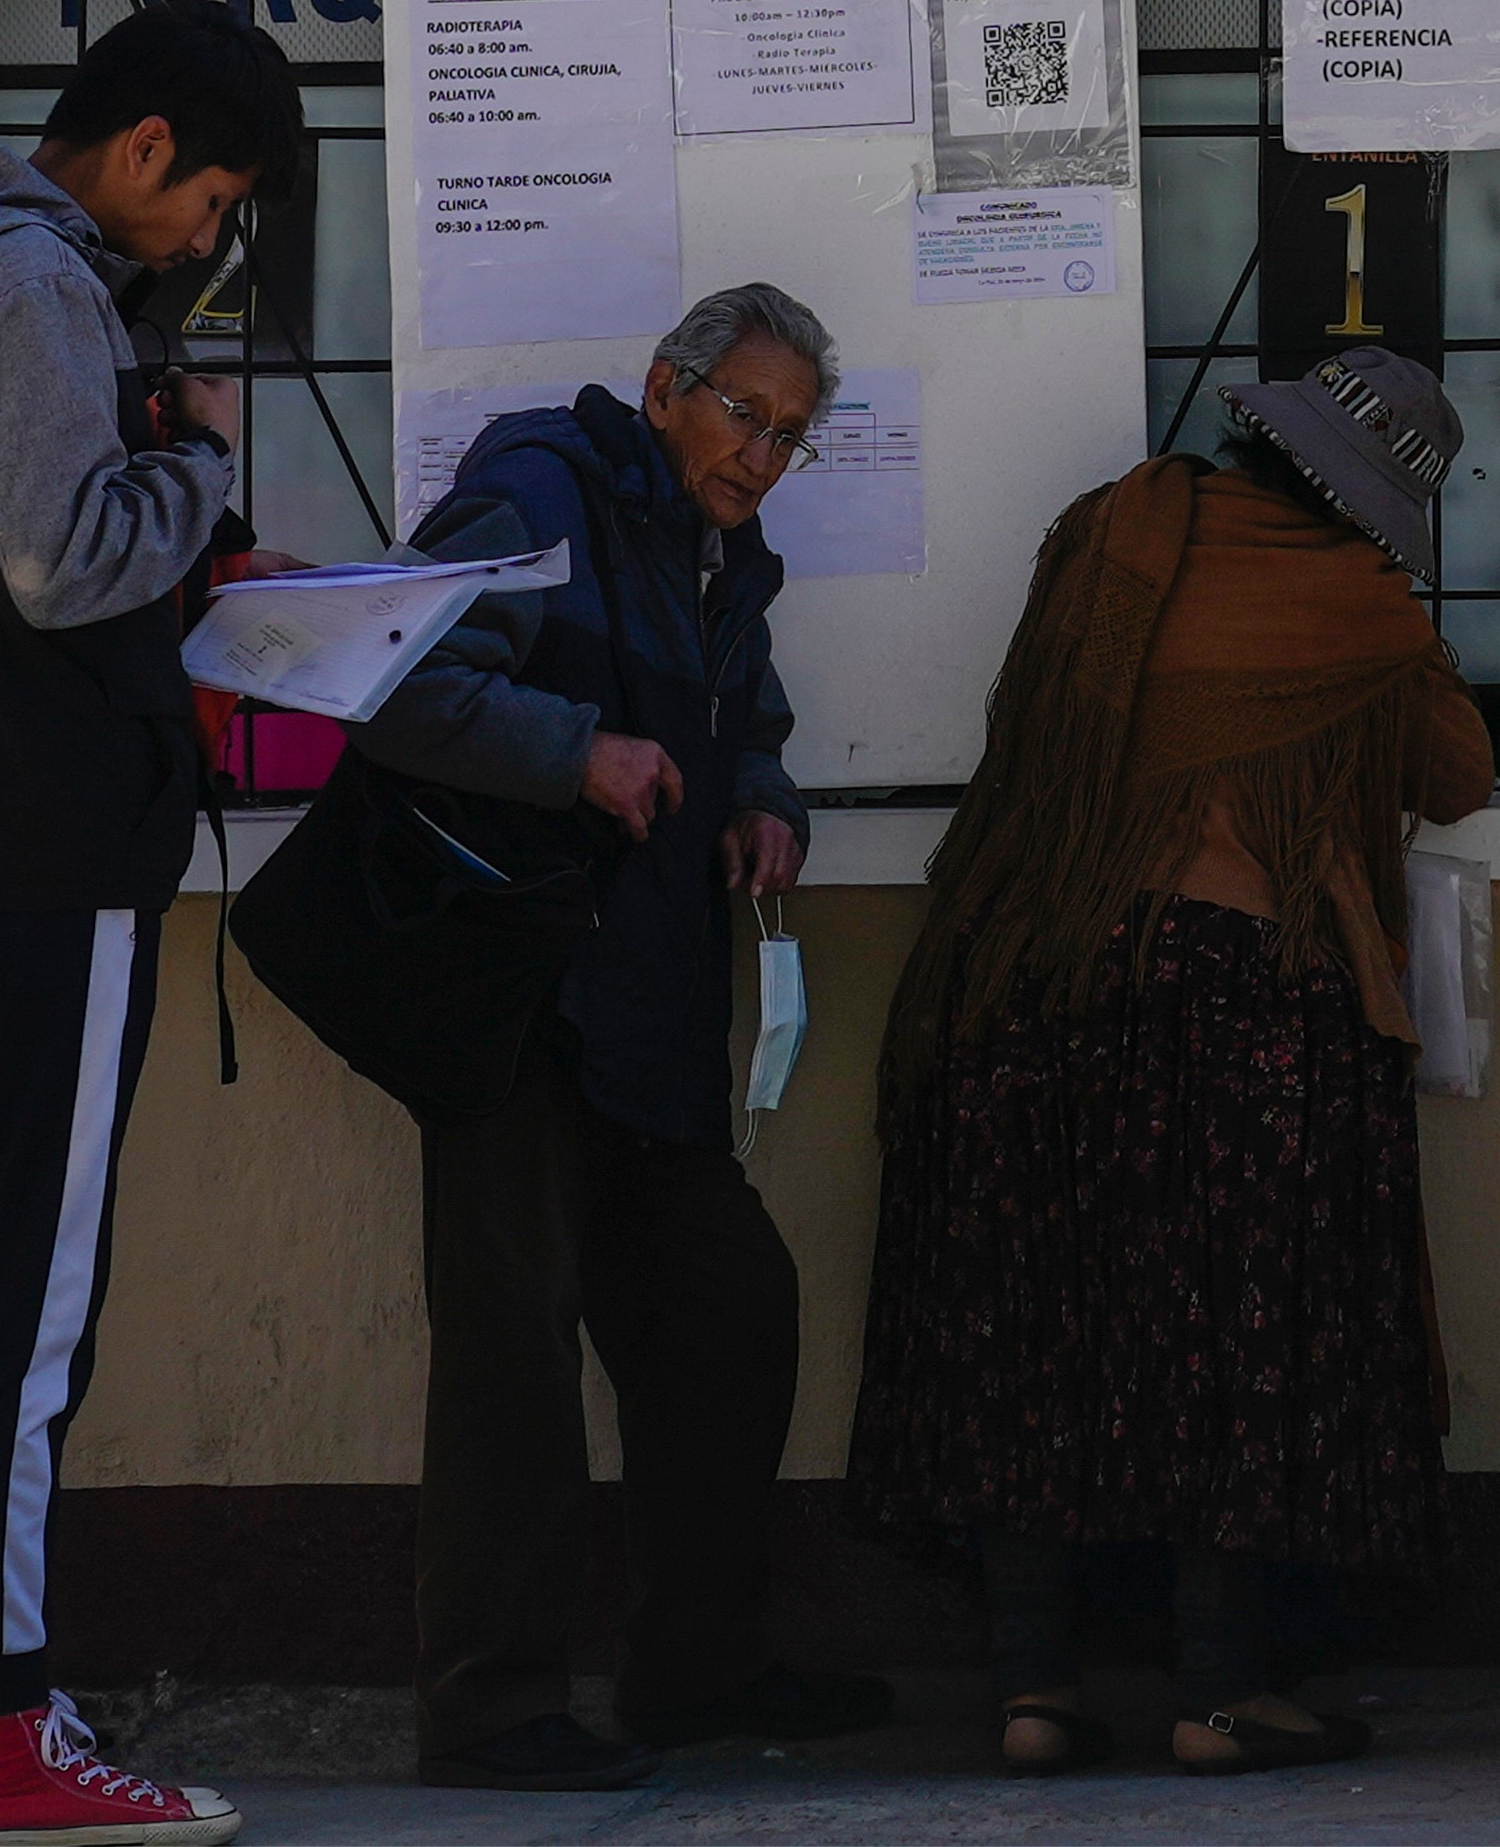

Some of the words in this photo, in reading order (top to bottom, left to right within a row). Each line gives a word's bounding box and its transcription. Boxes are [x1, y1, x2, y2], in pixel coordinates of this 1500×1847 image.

[427, 20, 522, 33] RADIOTERAPIA
[429, 44, 463, 55] 06:40
[467, 45, 474, 54] a
[479, 42, 505, 54] 8:00
[509, 44, 532, 52] am.
[429, 67, 507, 80] ONCOLOGIA
[568, 65, 621, 76] CIRUJIA,
[1322, 59, 1402, 82] (COPIA)
[429, 89, 495, 102] PALIATIVA
[429, 112, 464, 123] 06:40
[468, 114, 475, 122] a
[480, 111, 513, 122] 10:00
[518, 111, 541, 121] am.
[1312, 152, 1417, 163] ENTANILLA
[438, 177, 483, 189] TURNO
[488, 175, 529, 188] TARDE
[533, 173, 612, 186] ONCOLOGIA
[438, 199, 488, 211] CLINICA
[436, 222, 471, 233] 09:30
[475, 224, 482, 232] a
[487, 220, 521, 231] 12:00
[524, 220, 548, 232] pm.
[1325, 183, 1383, 335] 1
